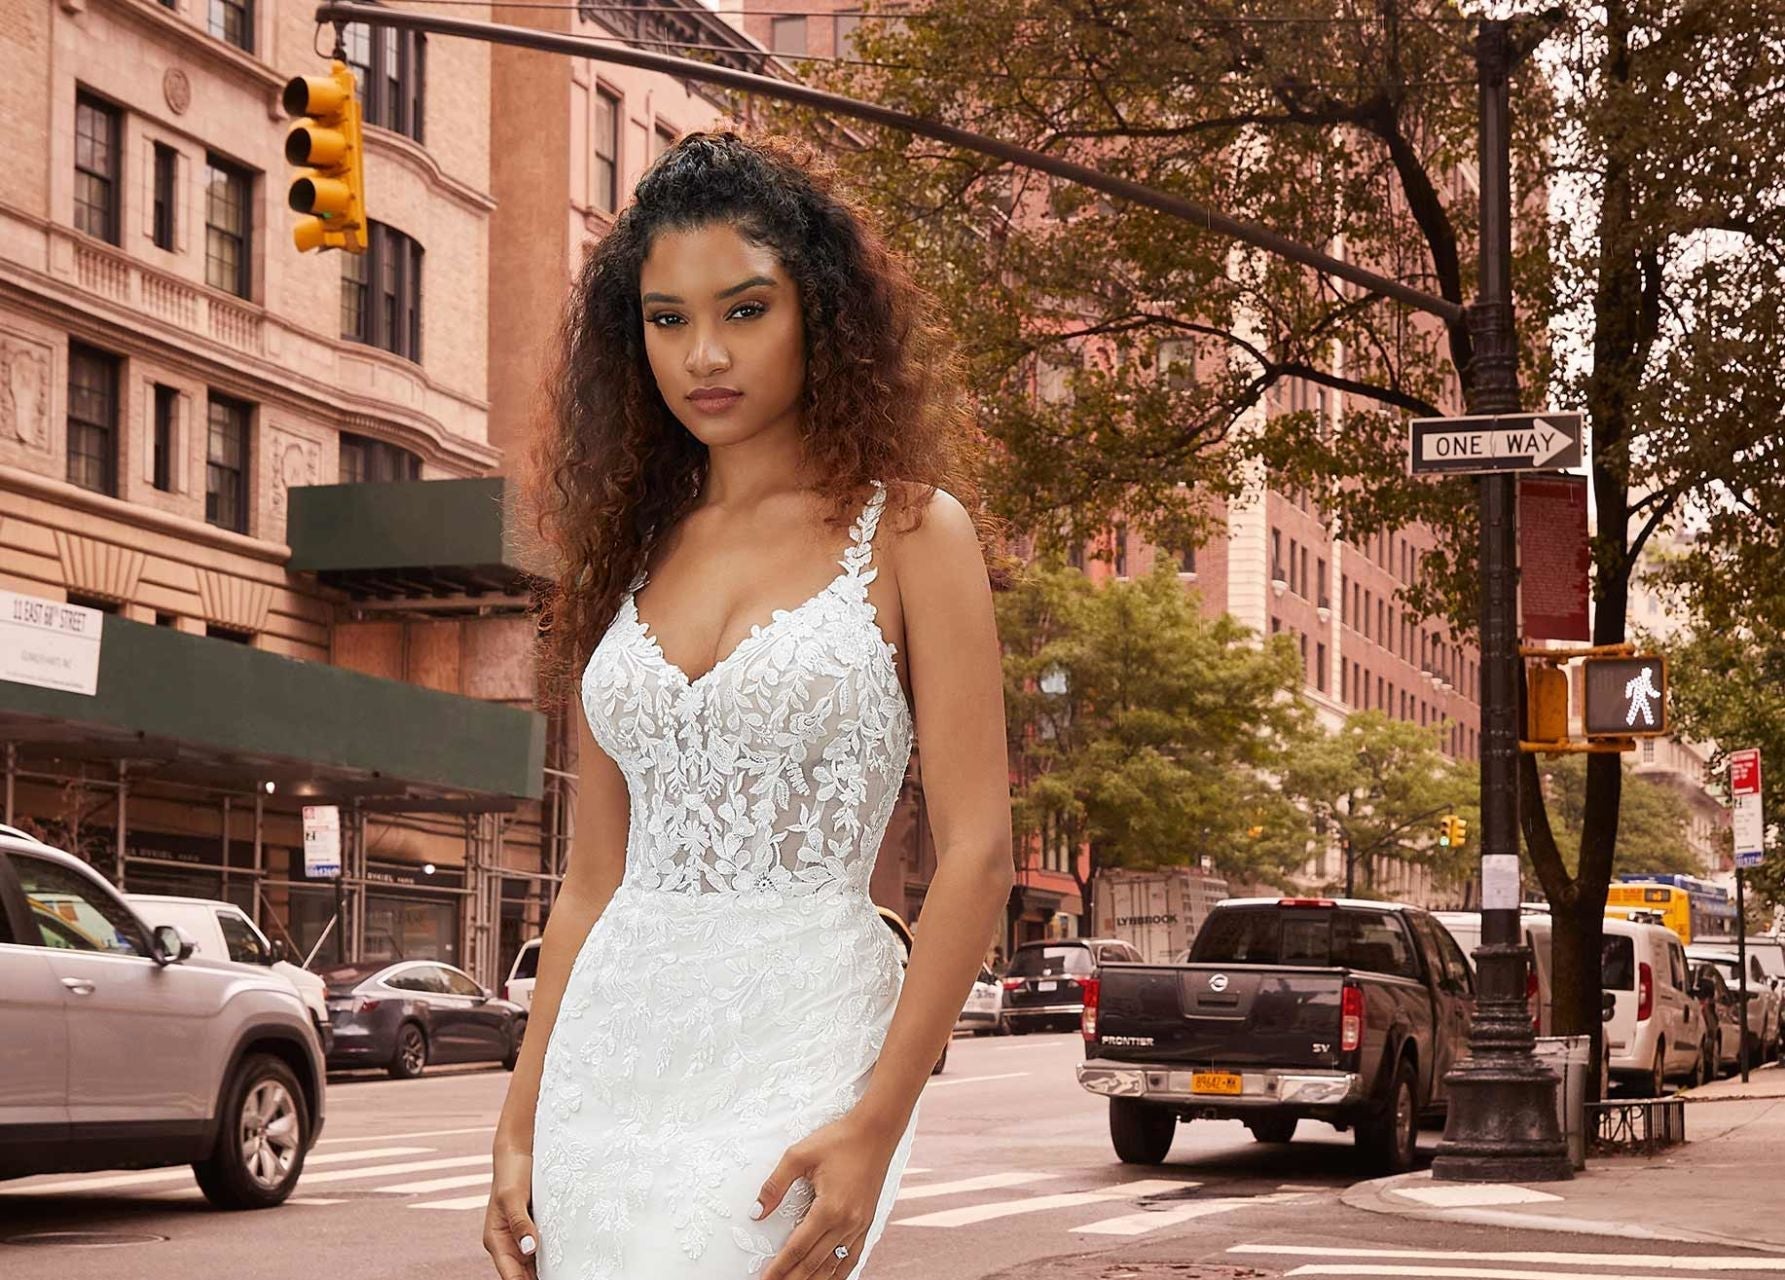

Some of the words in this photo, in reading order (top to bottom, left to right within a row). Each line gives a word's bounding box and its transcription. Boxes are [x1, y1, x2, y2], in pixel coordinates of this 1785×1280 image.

[1436, 435, 1483, 456] ONE
[1506, 432, 1555, 453] WAY
[24, 601, 43, 623] EAST
[60, 608, 86, 632] STREET
[1102, 1036, 1154, 1047] FRONTIER
[1313, 1043, 1331, 1054] SV
